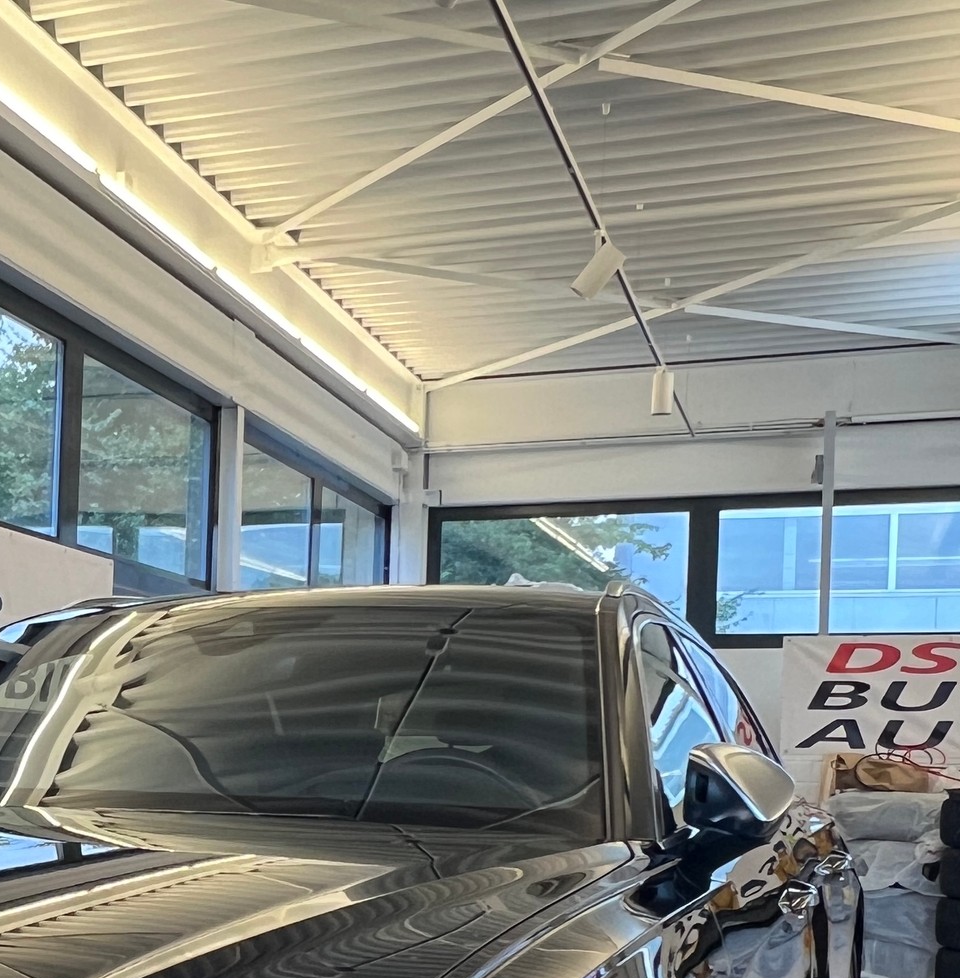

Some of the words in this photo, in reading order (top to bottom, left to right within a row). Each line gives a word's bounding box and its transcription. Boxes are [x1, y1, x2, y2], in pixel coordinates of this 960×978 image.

[826, 642, 960, 674] DS
[807, 681, 957, 711] BU
[795, 719, 953, 750] AU
